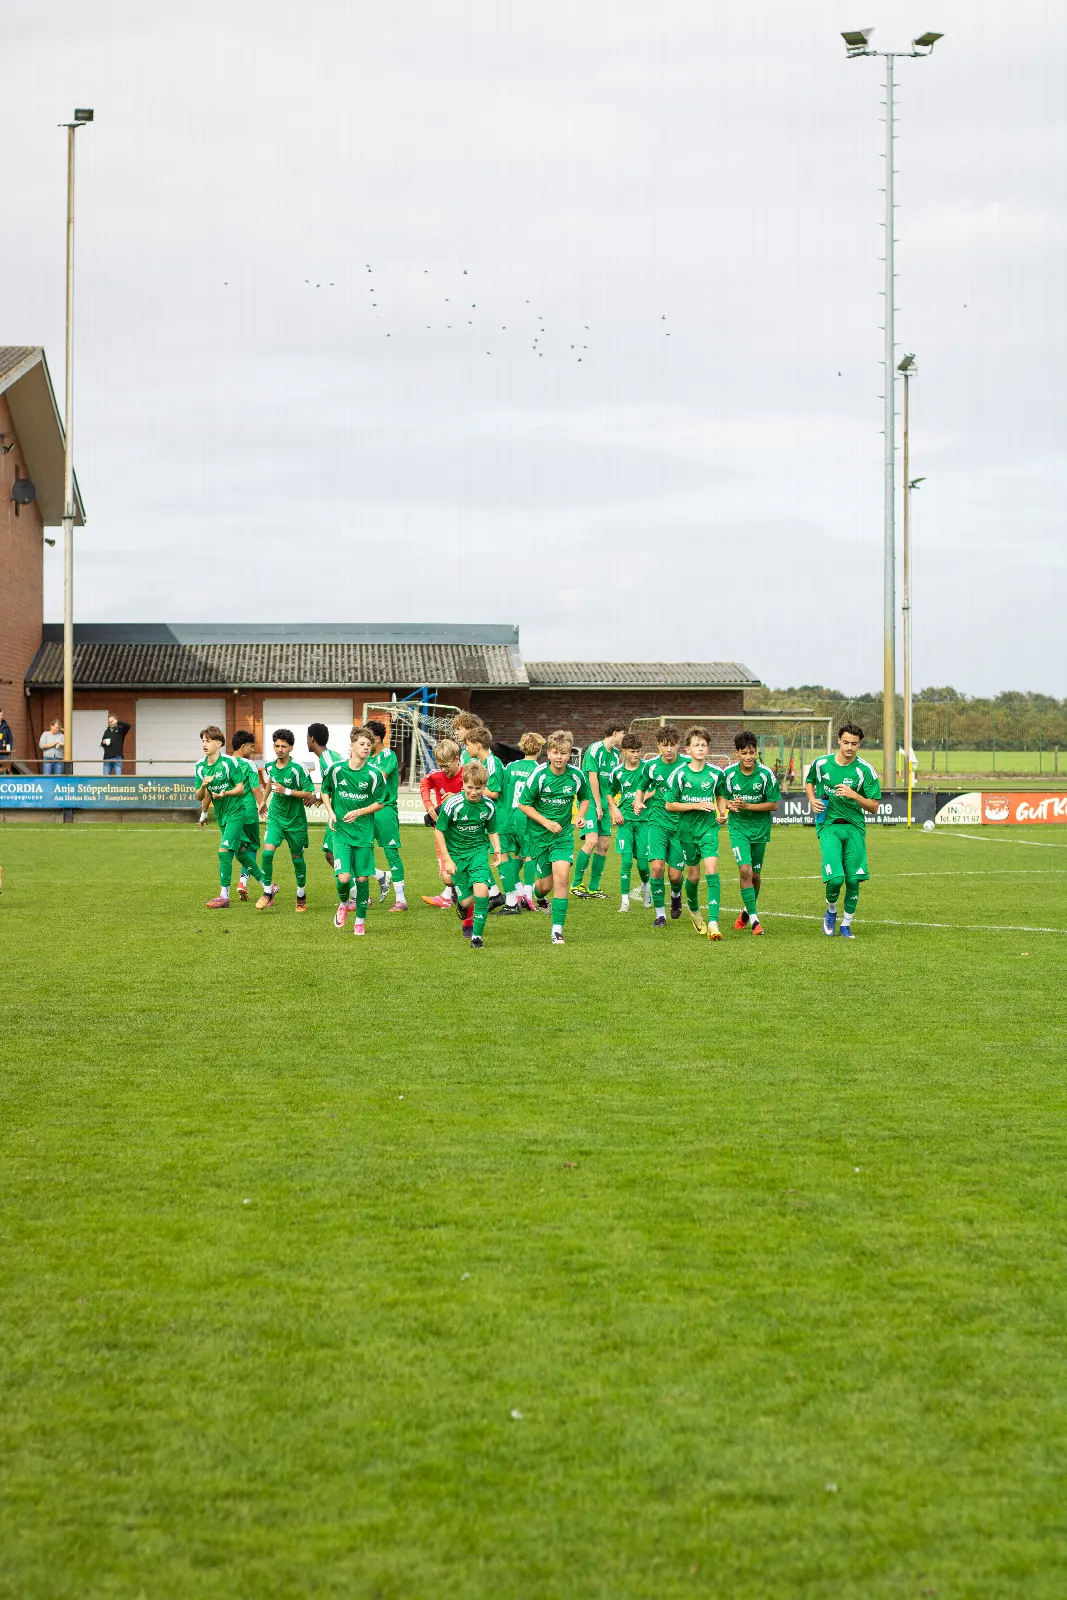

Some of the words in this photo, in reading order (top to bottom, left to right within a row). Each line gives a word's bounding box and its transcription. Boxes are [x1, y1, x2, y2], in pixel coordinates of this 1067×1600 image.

[54, 783, 75, 795] Anja
[77, 783, 136, 795] Stöppelmann
[138, 783, 195, 793] Service-Büro
[148, 793, 156, 801] 54
[157, 793, 165, 801] 91
[169, 793, 178, 801] 67
[180, 793, 187, 801] 17
[784, 801, 811, 815] INJ
[947, 806, 980, 815] INJOY
[772, 815, 802, 824] Spezialist
[804, 815, 814, 823] für
[877, 815, 882, 823] &
[883, 815, 916, 824] Abnehmn
[940, 815, 951, 823] Tel.
[952, 815, 960, 823] 67
[963, 815, 970, 823] 11
[971, 815, 980, 823] 67
